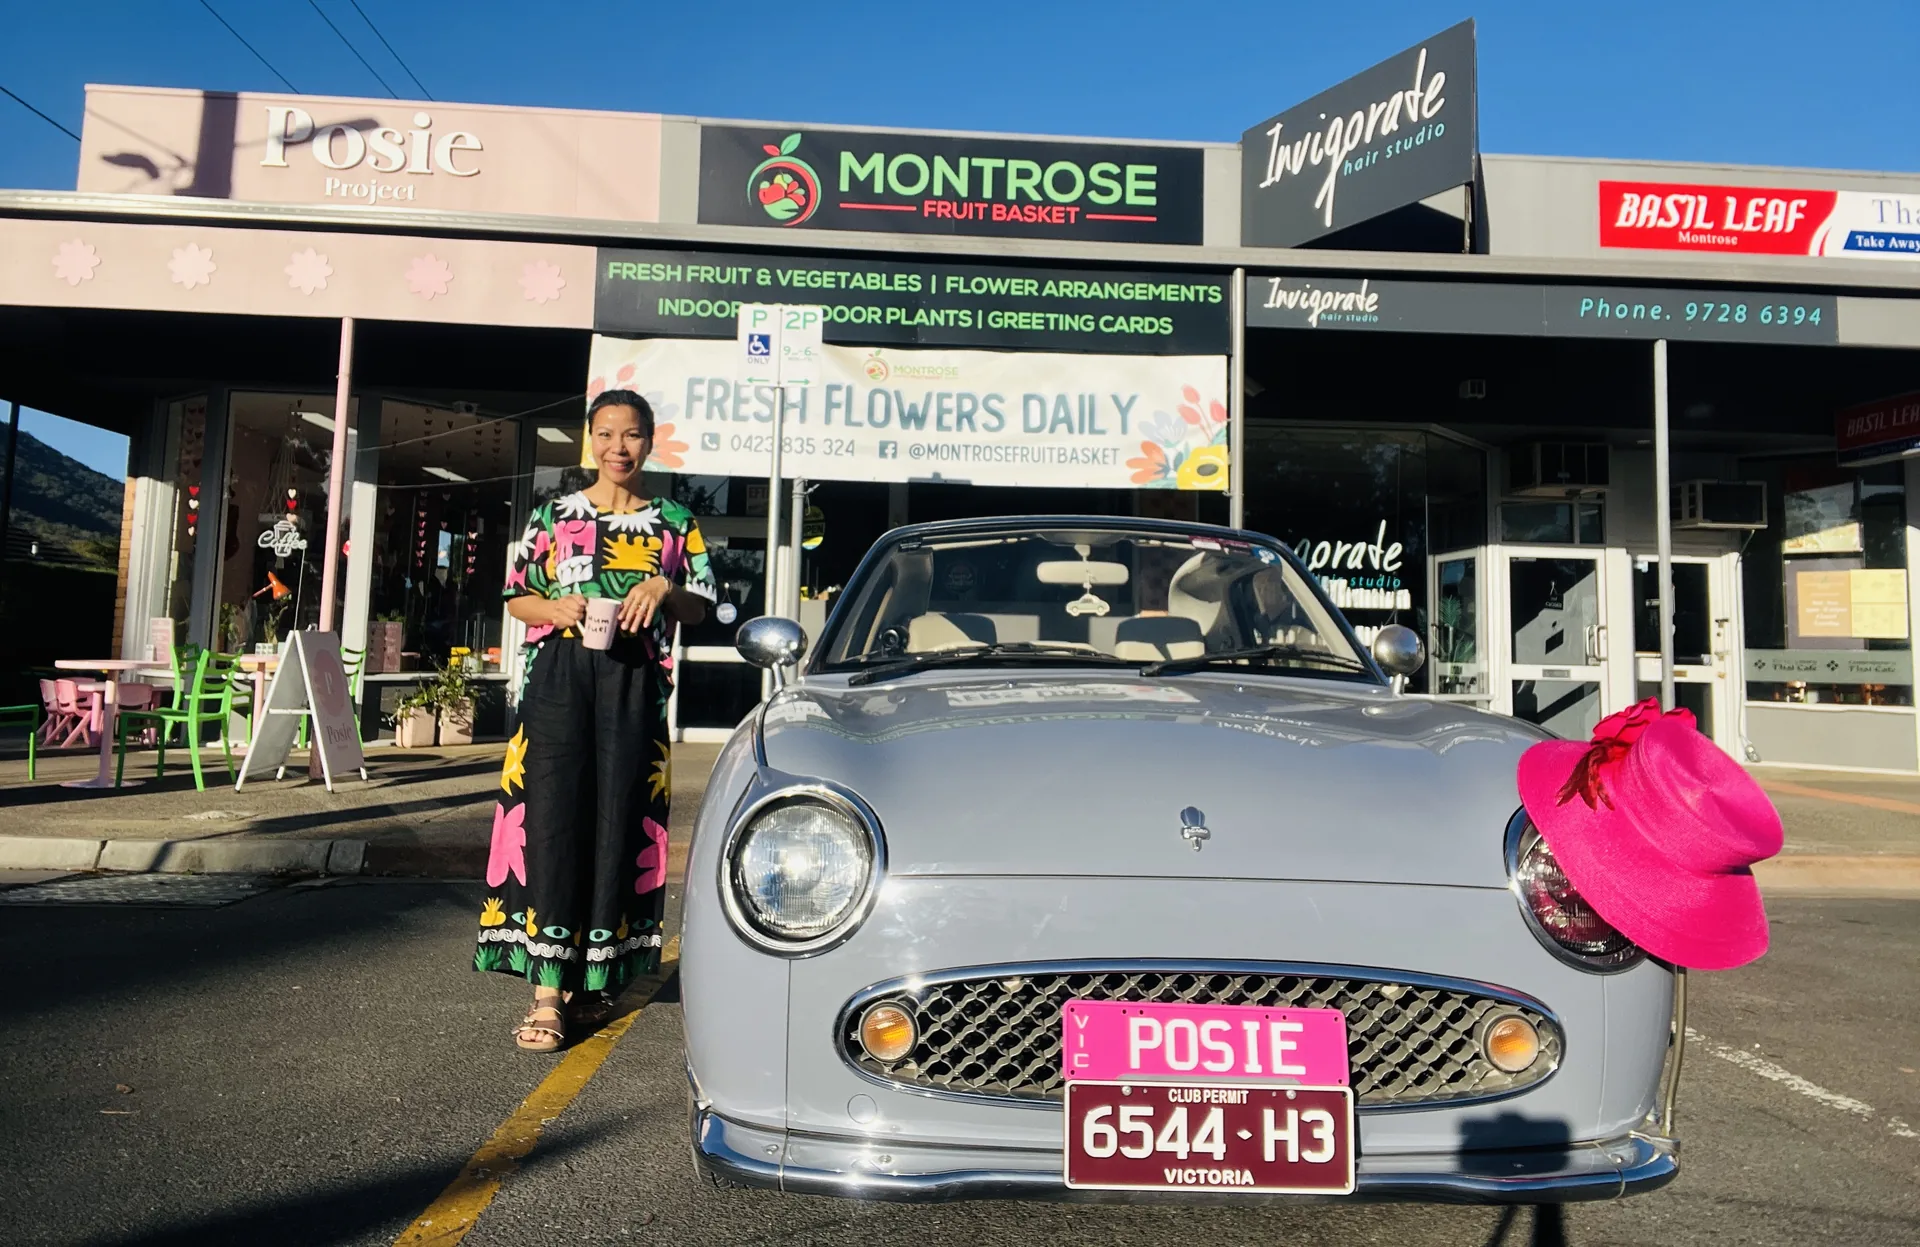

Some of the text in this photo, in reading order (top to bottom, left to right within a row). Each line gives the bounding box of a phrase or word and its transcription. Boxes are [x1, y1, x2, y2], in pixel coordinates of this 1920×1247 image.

[260, 106, 483, 177] Posie
[1259, 47, 1446, 228] Invigorate
[1343, 123, 1445, 176] hair studio
[325, 177, 416, 205] Project
[839, 151, 1158, 206] MONTROSE
[923, 200, 1080, 225] FRUIT BASKET
[1615, 193, 1808, 233] BASIL LEAF
[1678, 230, 1738, 246] Montrose
[1855, 234, 1885, 249] Take
[608, 262, 682, 282] FRESH
[687, 264, 752, 285] FRUIT
[756, 267, 772, 287] &
[777, 268, 922, 292] VEGETABLES
[946, 275, 1039, 297] FLOWER
[1042, 279, 1223, 304] ARRANGEMENTS
[1263, 276, 1379, 328] Invigorate
[1580, 298, 1822, 326] Phone. 9728 6394
[752, 309, 768, 328] P
[785, 311, 818, 330] 2P
[886, 307, 973, 328] PLANTS
[988, 311, 1095, 332] GREETING
[1099, 315, 1174, 335] CARDS
[1320, 313, 1379, 323] hair studio
[748, 356, 770, 364] ONLY
[893, 365, 959, 376] MONTROSE
[685, 377, 1141, 436] FRESH FLOWERS DAILY
[1846, 411, 1888, 438] BASIL
[730, 434, 1120, 466] 0423 835 324 @MONTROSEFRUITBASKET
[258, 529, 308, 553] Coffee
[803, 524, 824, 534] PEN
[1350, 574, 1401, 588] studio
[1074, 1015, 1090, 1068] VIC
[1129, 1016, 1306, 1076] POSIE
[1168, 1088, 1249, 1105] CLUB PERMIT
[1164, 1168, 1254, 1186] VICTORIA
